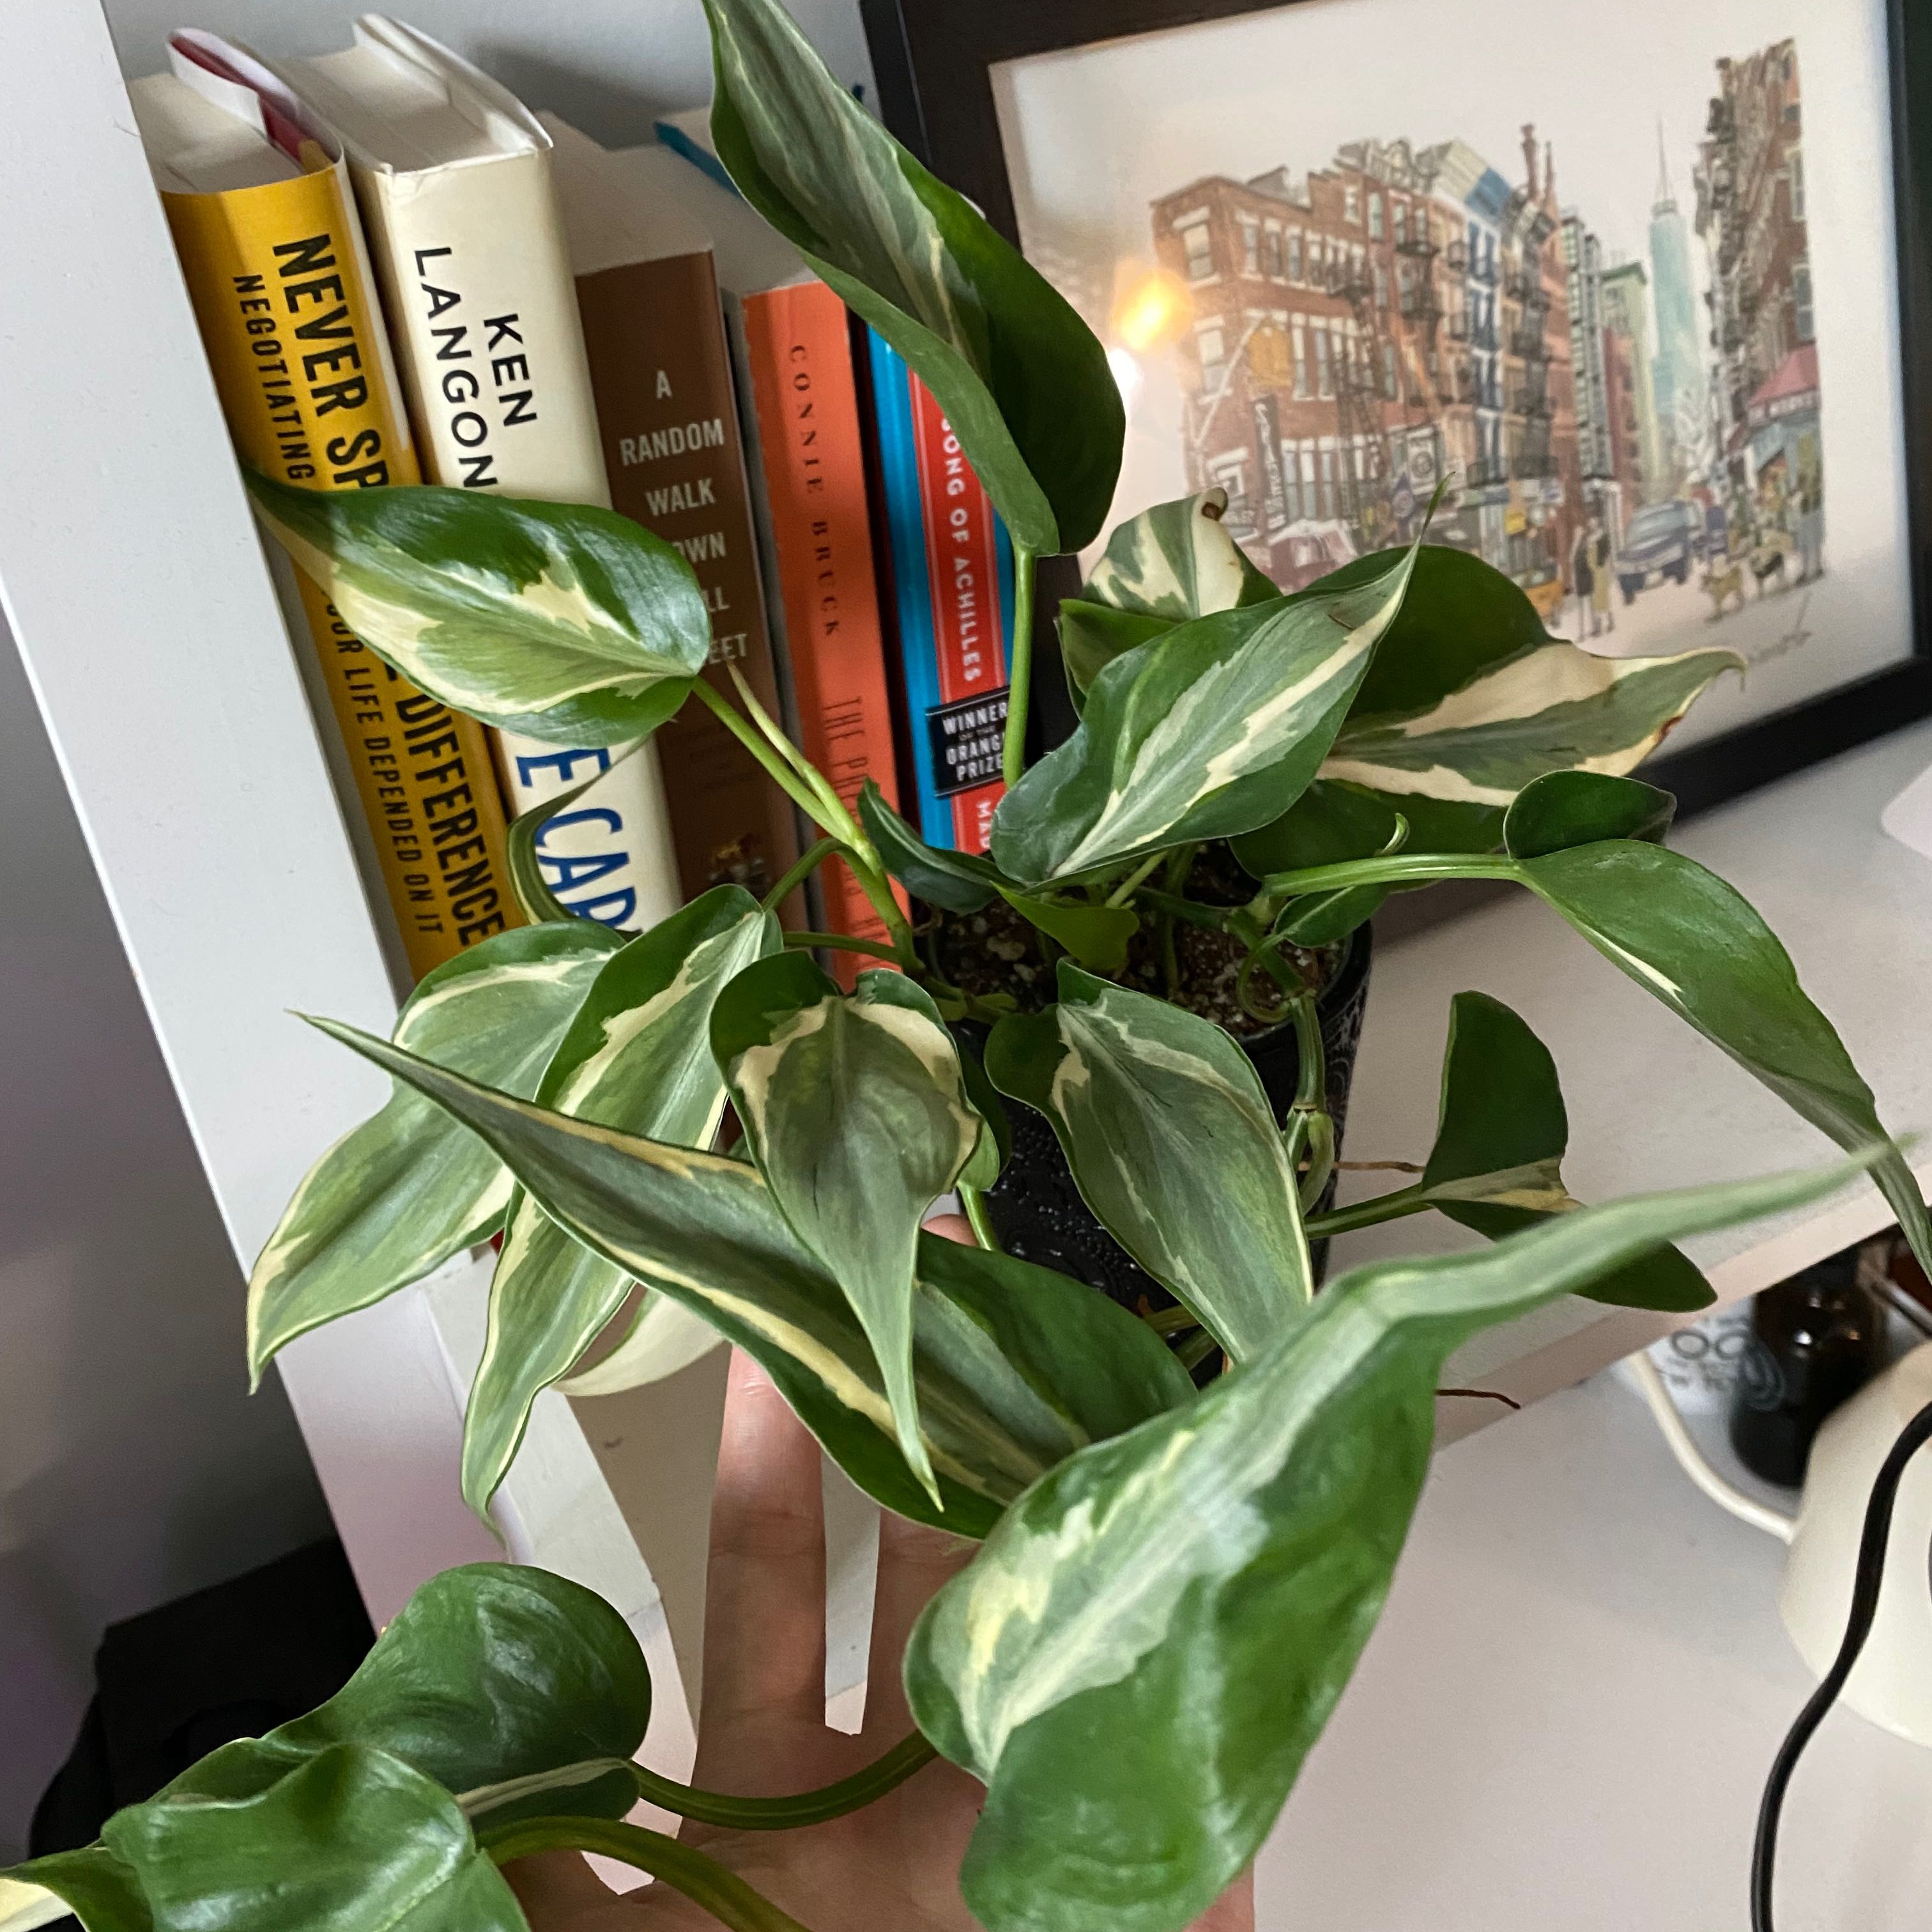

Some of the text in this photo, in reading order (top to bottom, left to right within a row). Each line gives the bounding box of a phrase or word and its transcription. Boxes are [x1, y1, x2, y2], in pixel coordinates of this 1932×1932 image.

[233, 274, 316, 480] NEGOTIATING
[483, 313, 537, 427] KEN
[656, 369, 673, 400] A
[789, 345, 824, 493] CONNIE
[618, 418, 725, 466] RANDOM
[645, 478, 716, 517] WALK
[950, 509, 970, 542] OF
[272, 233, 369, 418] NEVER
[395, 694, 506, 946] DIFFERENCE
[954, 557, 982, 682] ACHILLES
[344, 668, 384, 724] LIFE
[942, 702, 1008, 735] WINNER
[946, 732, 1005, 765] ORANG
[957, 753, 1003, 781] PRIZE
[364, 737, 422, 861] DEPENDED
[404, 874, 435, 902] ON
[415, 914, 443, 933] IT
